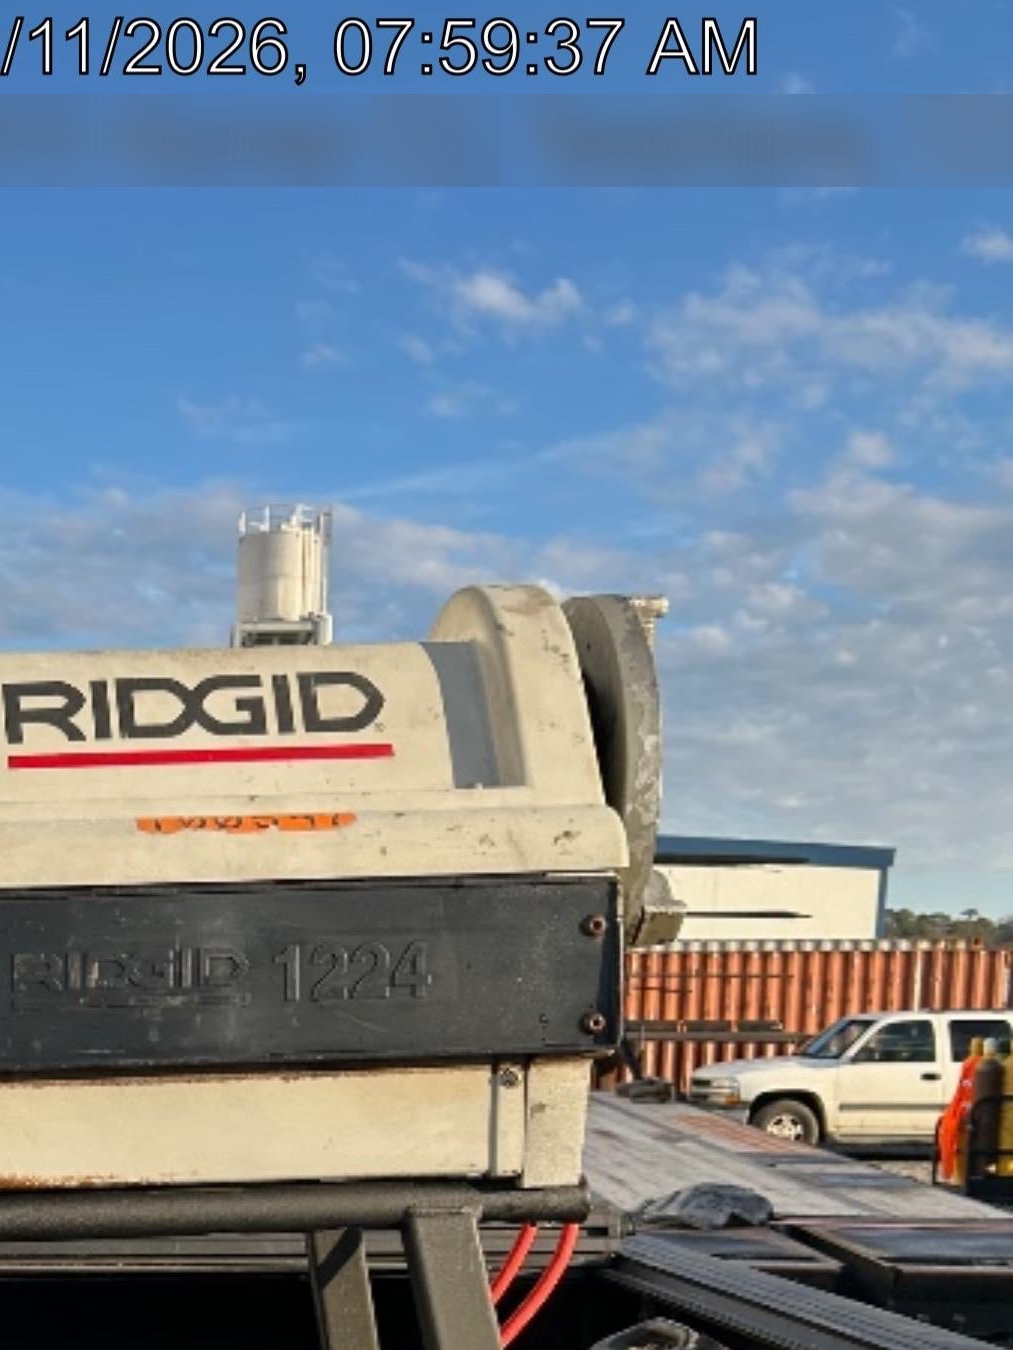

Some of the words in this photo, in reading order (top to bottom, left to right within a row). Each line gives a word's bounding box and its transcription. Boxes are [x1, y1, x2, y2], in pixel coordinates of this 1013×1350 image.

[1, 671, 386, 744] RIDGID
[12, 944, 251, 993] RIDGID
[273, 938, 434, 1002] 1224
